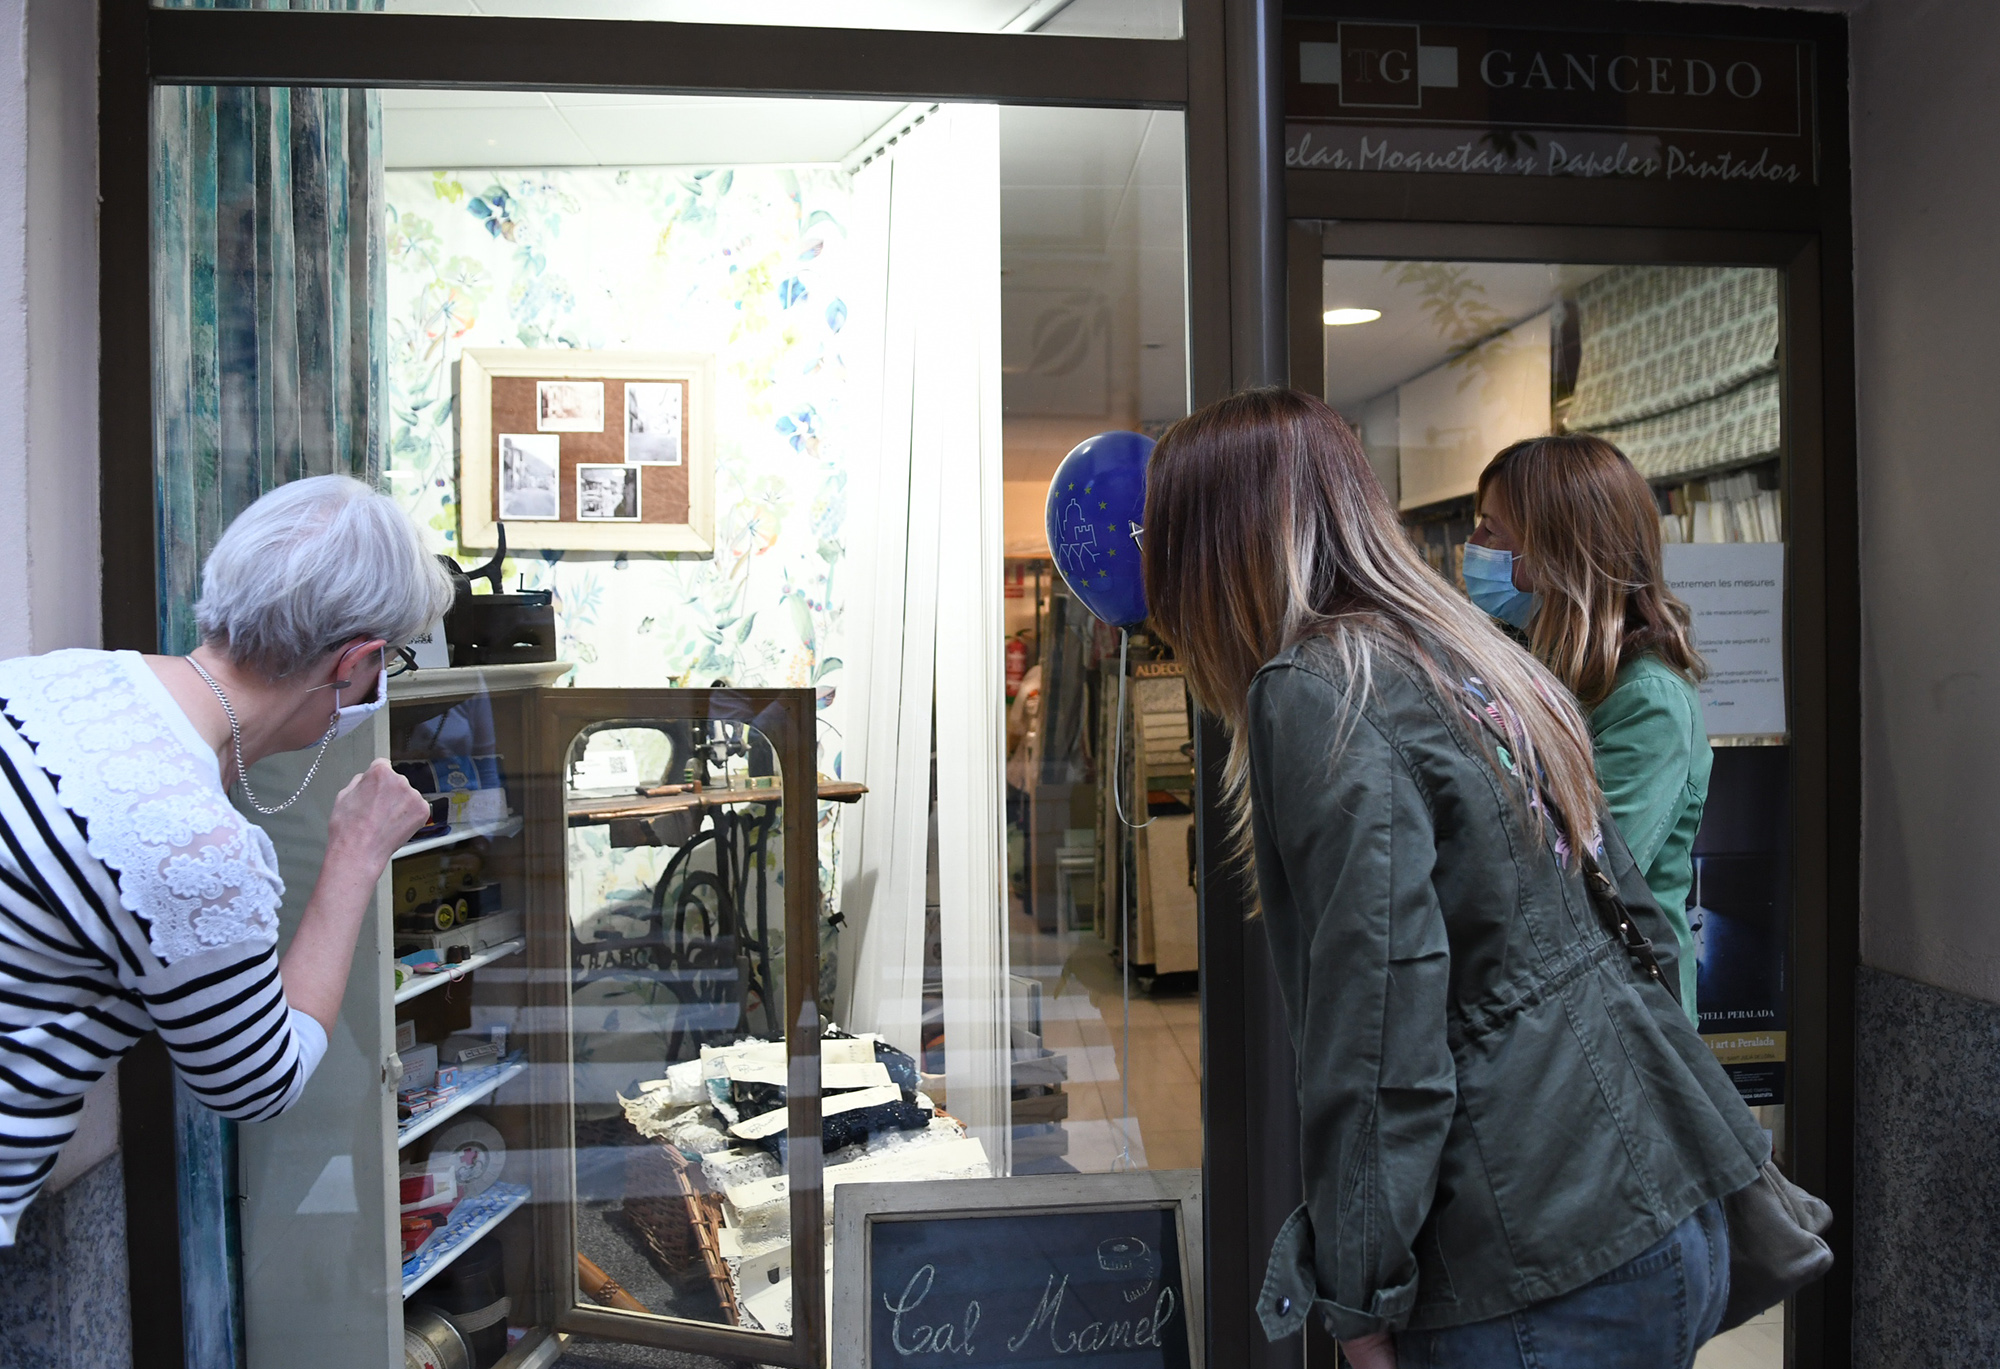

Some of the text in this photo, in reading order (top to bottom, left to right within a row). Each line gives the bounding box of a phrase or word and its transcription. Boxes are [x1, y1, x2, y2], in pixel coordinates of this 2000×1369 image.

[1480, 49, 1763, 99] GANCEDO
[1285, 132, 1801, 184] elas, Moquetas y Papeles Pintados
[1718, 579, 1732, 588] les
[1734, 579, 1776, 588] mesures
[1698, 1010, 1775, 1020] STELL PERALADA
[1716, 1039, 1729, 1050] art
[1738, 1036, 1775, 1048] Peralada
[883, 1263, 1176, 1356] Cal Manel
